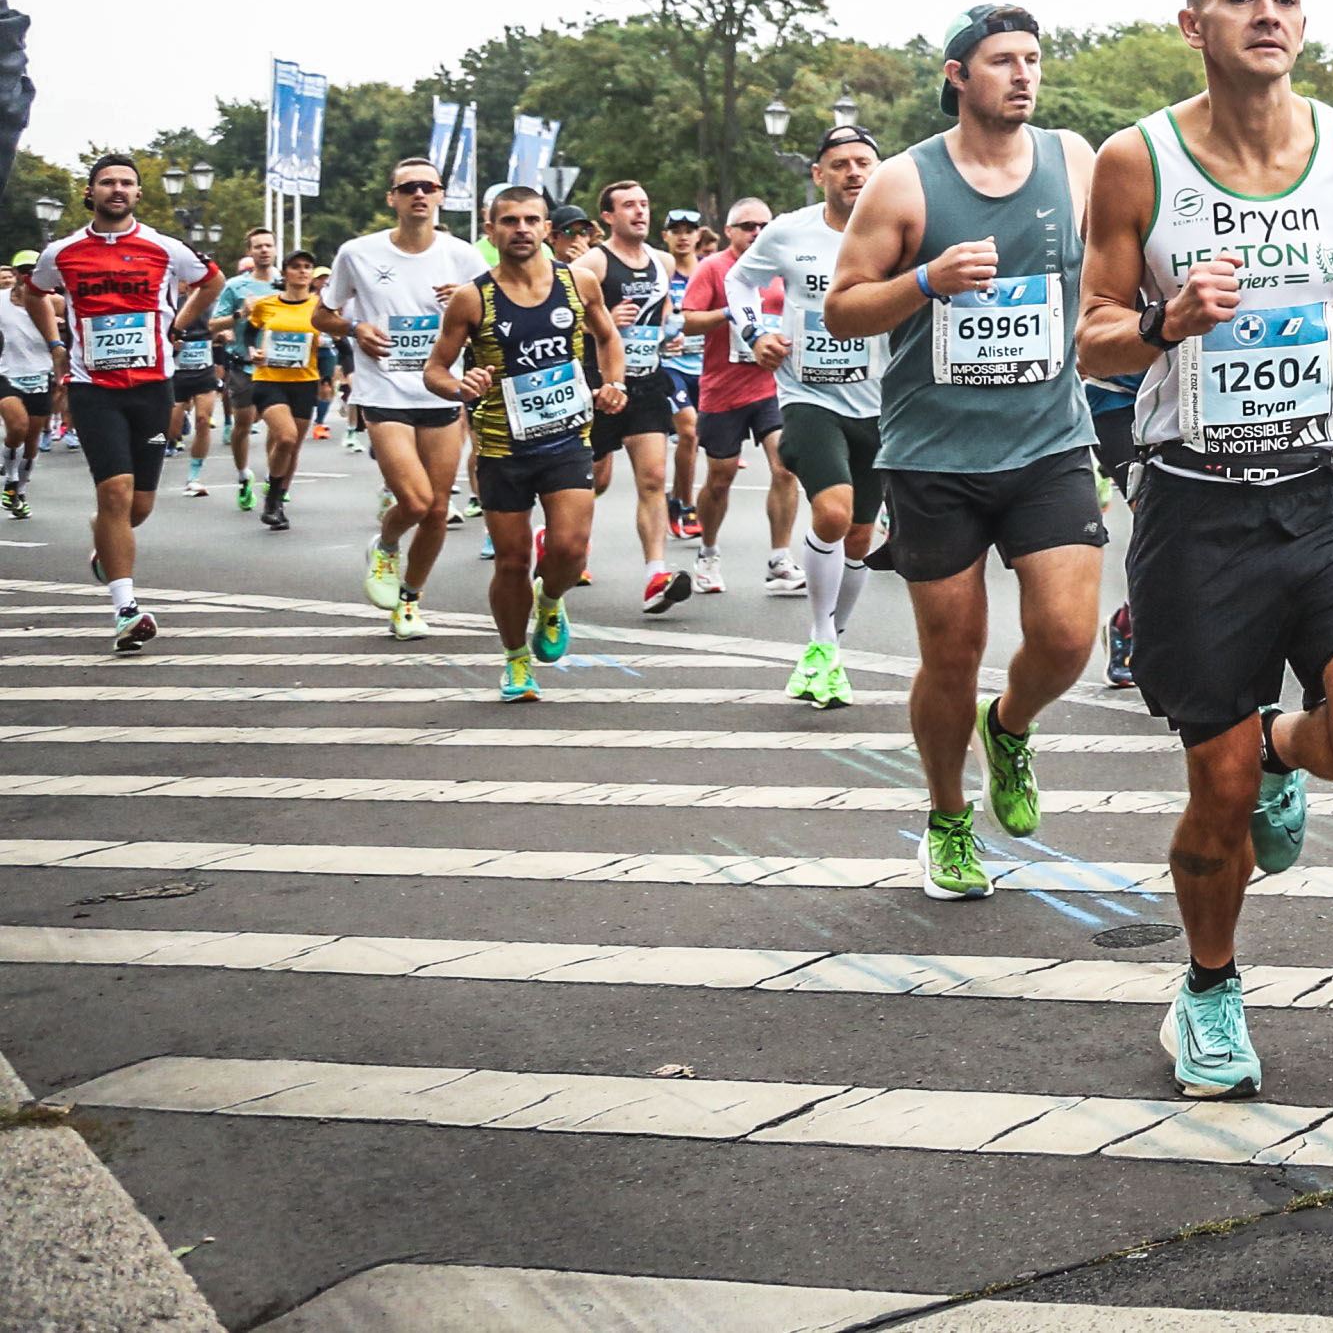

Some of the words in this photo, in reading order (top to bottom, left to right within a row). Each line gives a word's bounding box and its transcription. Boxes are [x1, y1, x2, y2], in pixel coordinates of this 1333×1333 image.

[1213, 202, 1319, 243] Bryan
[1045, 224, 1056, 270] NIKE
[1171, 242, 1309, 277] HETON
[958, 314, 1040, 340] 69961
[95, 332, 144, 348] 72072
[390, 335, 436, 348] 50874
[805, 336, 865, 352] 22508
[977, 345, 1024, 358] Alister
[819, 357, 849, 365] Lance
[952, 362, 1018, 375] IMPOSSIBLE
[952, 375, 963, 384] IS
[964, 375, 1016, 385] NOTHING
[1190, 373, 1198, 391] 2023
[1211, 355, 1321, 393] 12604
[520, 386, 575, 413] 59409
[1242, 399, 1296, 417] Bryan
[1191, 391, 1199, 431] September
[1206, 421, 1292, 440] IMPOSSIBLE
[1208, 441, 1220, 453] IS
[1222, 437, 1289, 454] NOTHING
